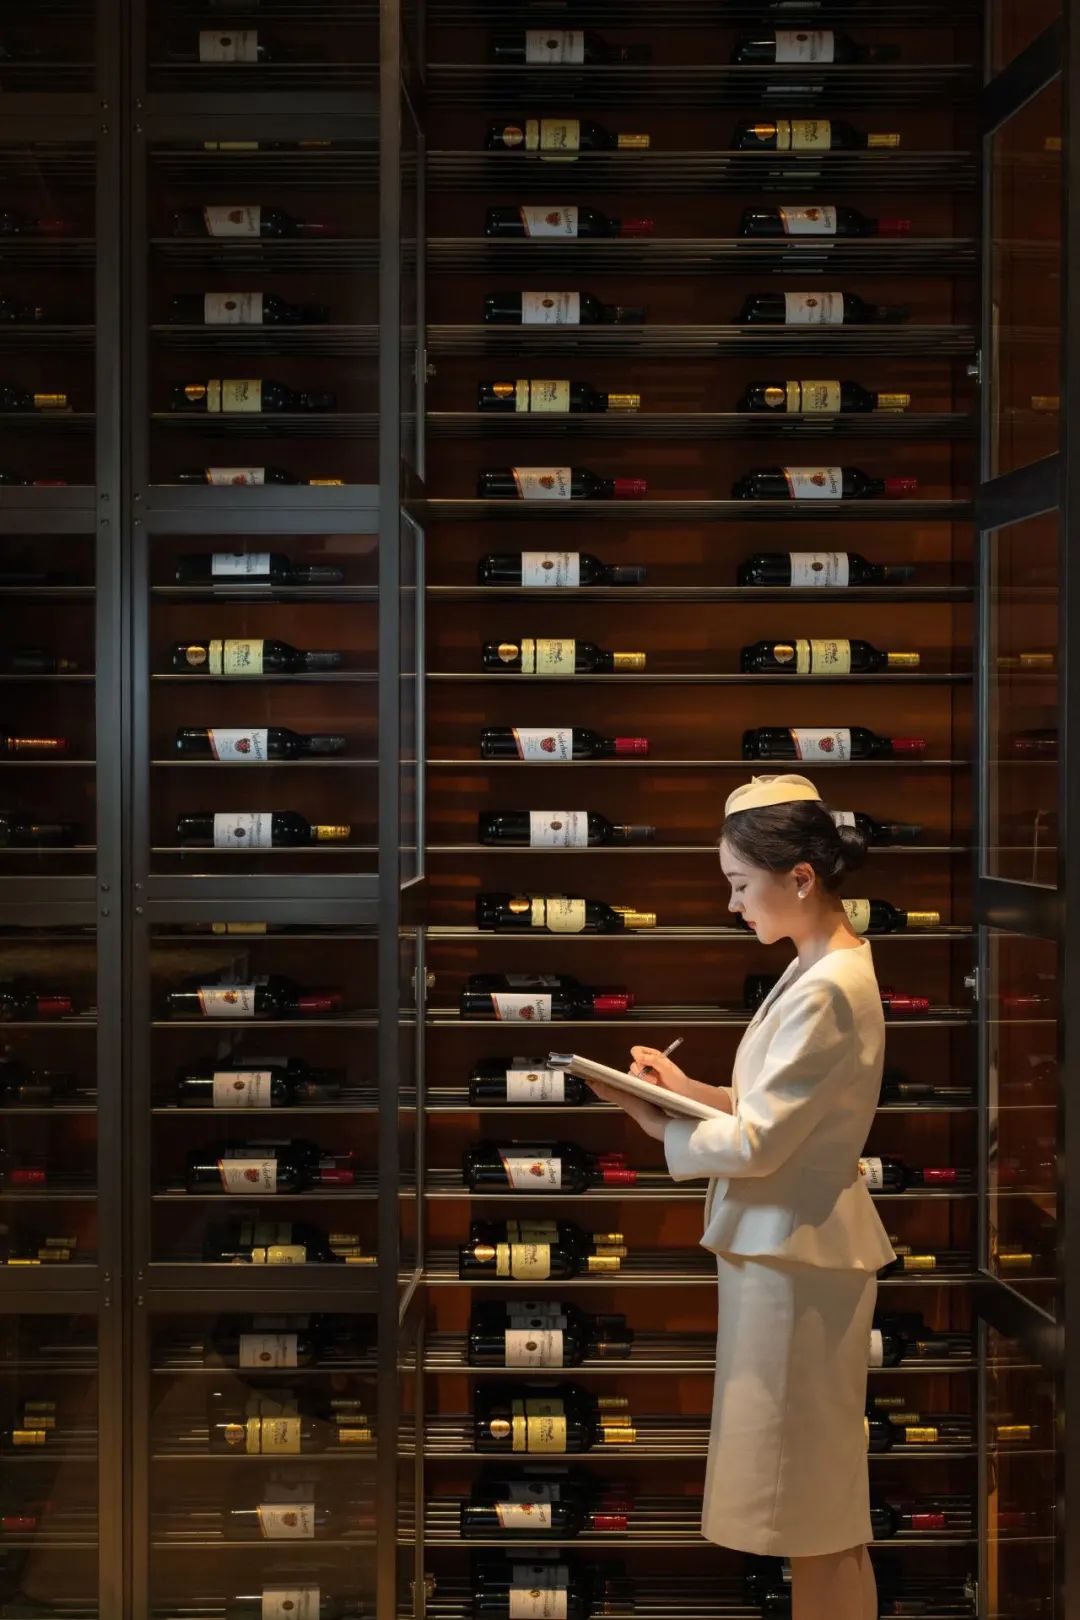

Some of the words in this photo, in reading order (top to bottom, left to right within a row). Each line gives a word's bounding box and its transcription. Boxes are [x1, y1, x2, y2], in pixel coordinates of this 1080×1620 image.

[251, 732, 263, 760] Nederburg
[557, 732, 569, 760] Nederburg
[834, 732, 847, 760] Nederburg
